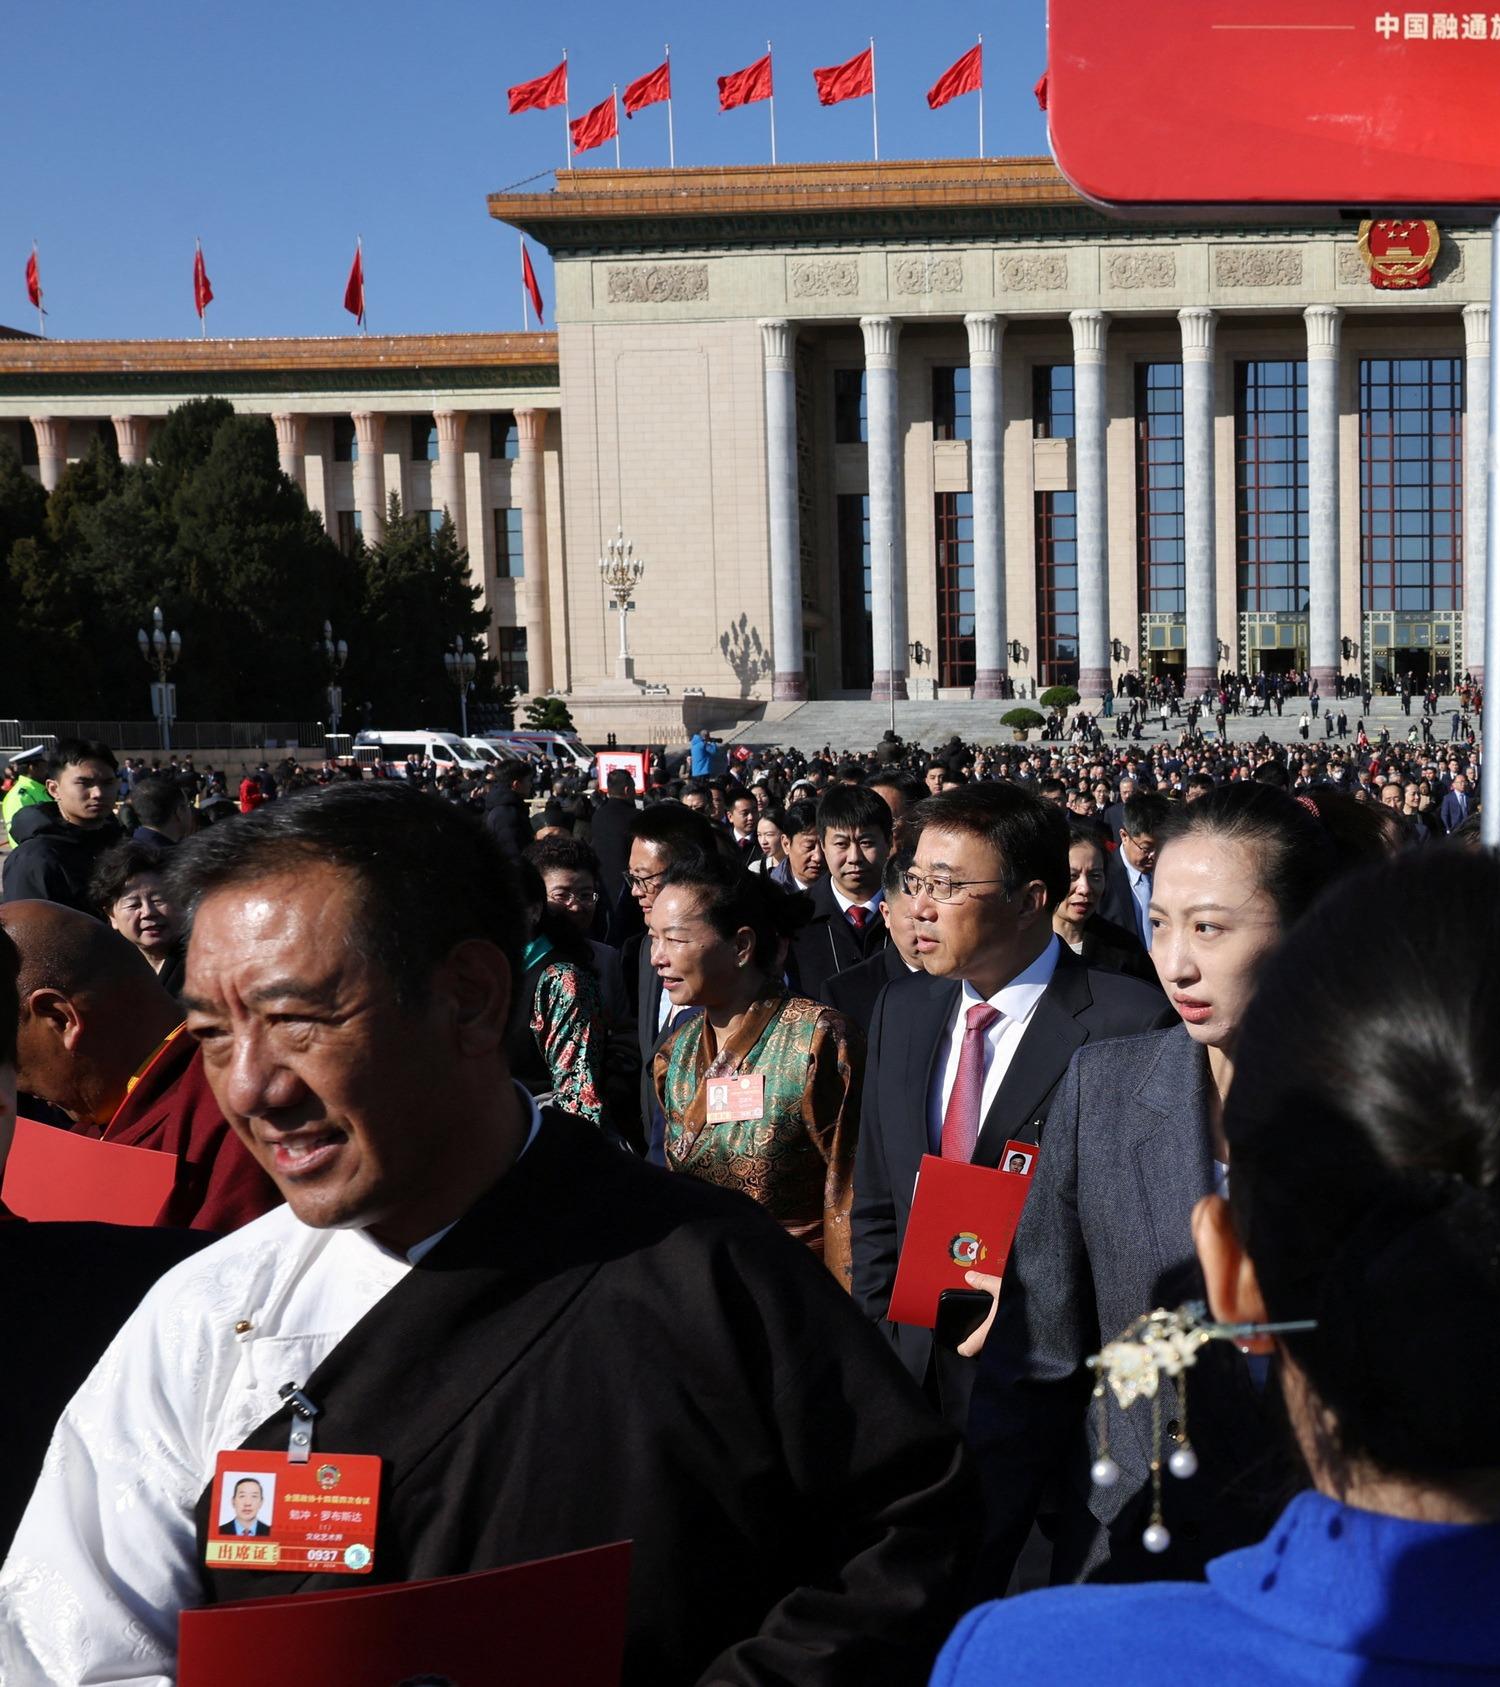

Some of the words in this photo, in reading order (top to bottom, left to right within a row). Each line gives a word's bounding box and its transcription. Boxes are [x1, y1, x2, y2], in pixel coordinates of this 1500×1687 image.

[218, 1544, 268, 1560] 出席证
[307, 1549, 338, 1561] 0937
